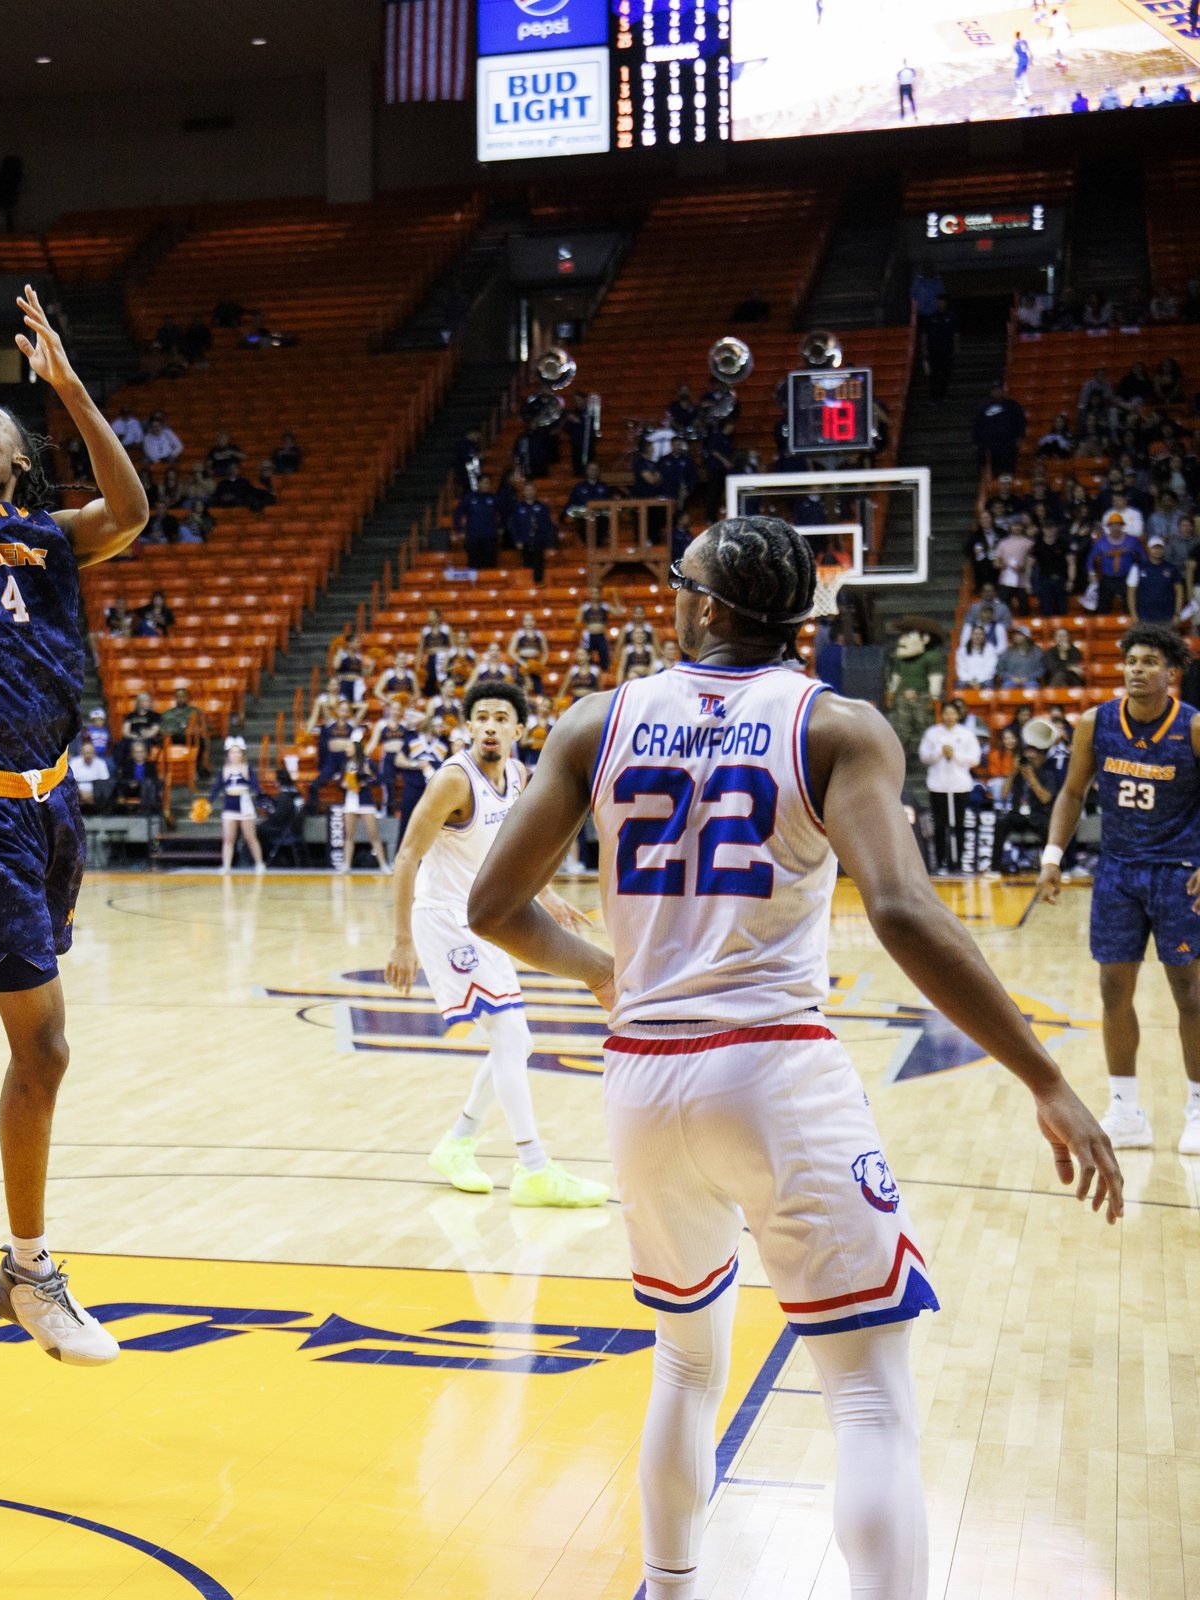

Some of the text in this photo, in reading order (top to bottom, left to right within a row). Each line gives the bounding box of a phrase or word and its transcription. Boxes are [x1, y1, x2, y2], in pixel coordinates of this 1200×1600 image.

[517, 16, 570, 40] pepsi
[508, 71, 577, 97] BUD
[494, 96, 591, 125] LIGHT
[822, 401, 856, 441] 18
[0, 573, 30, 623] 4
[632, 722, 771, 759] CRAWFORD
[1103, 755, 1176, 781] MINERS
[1117, 780, 1156, 811] 23
[613, 764, 779, 900] 22
